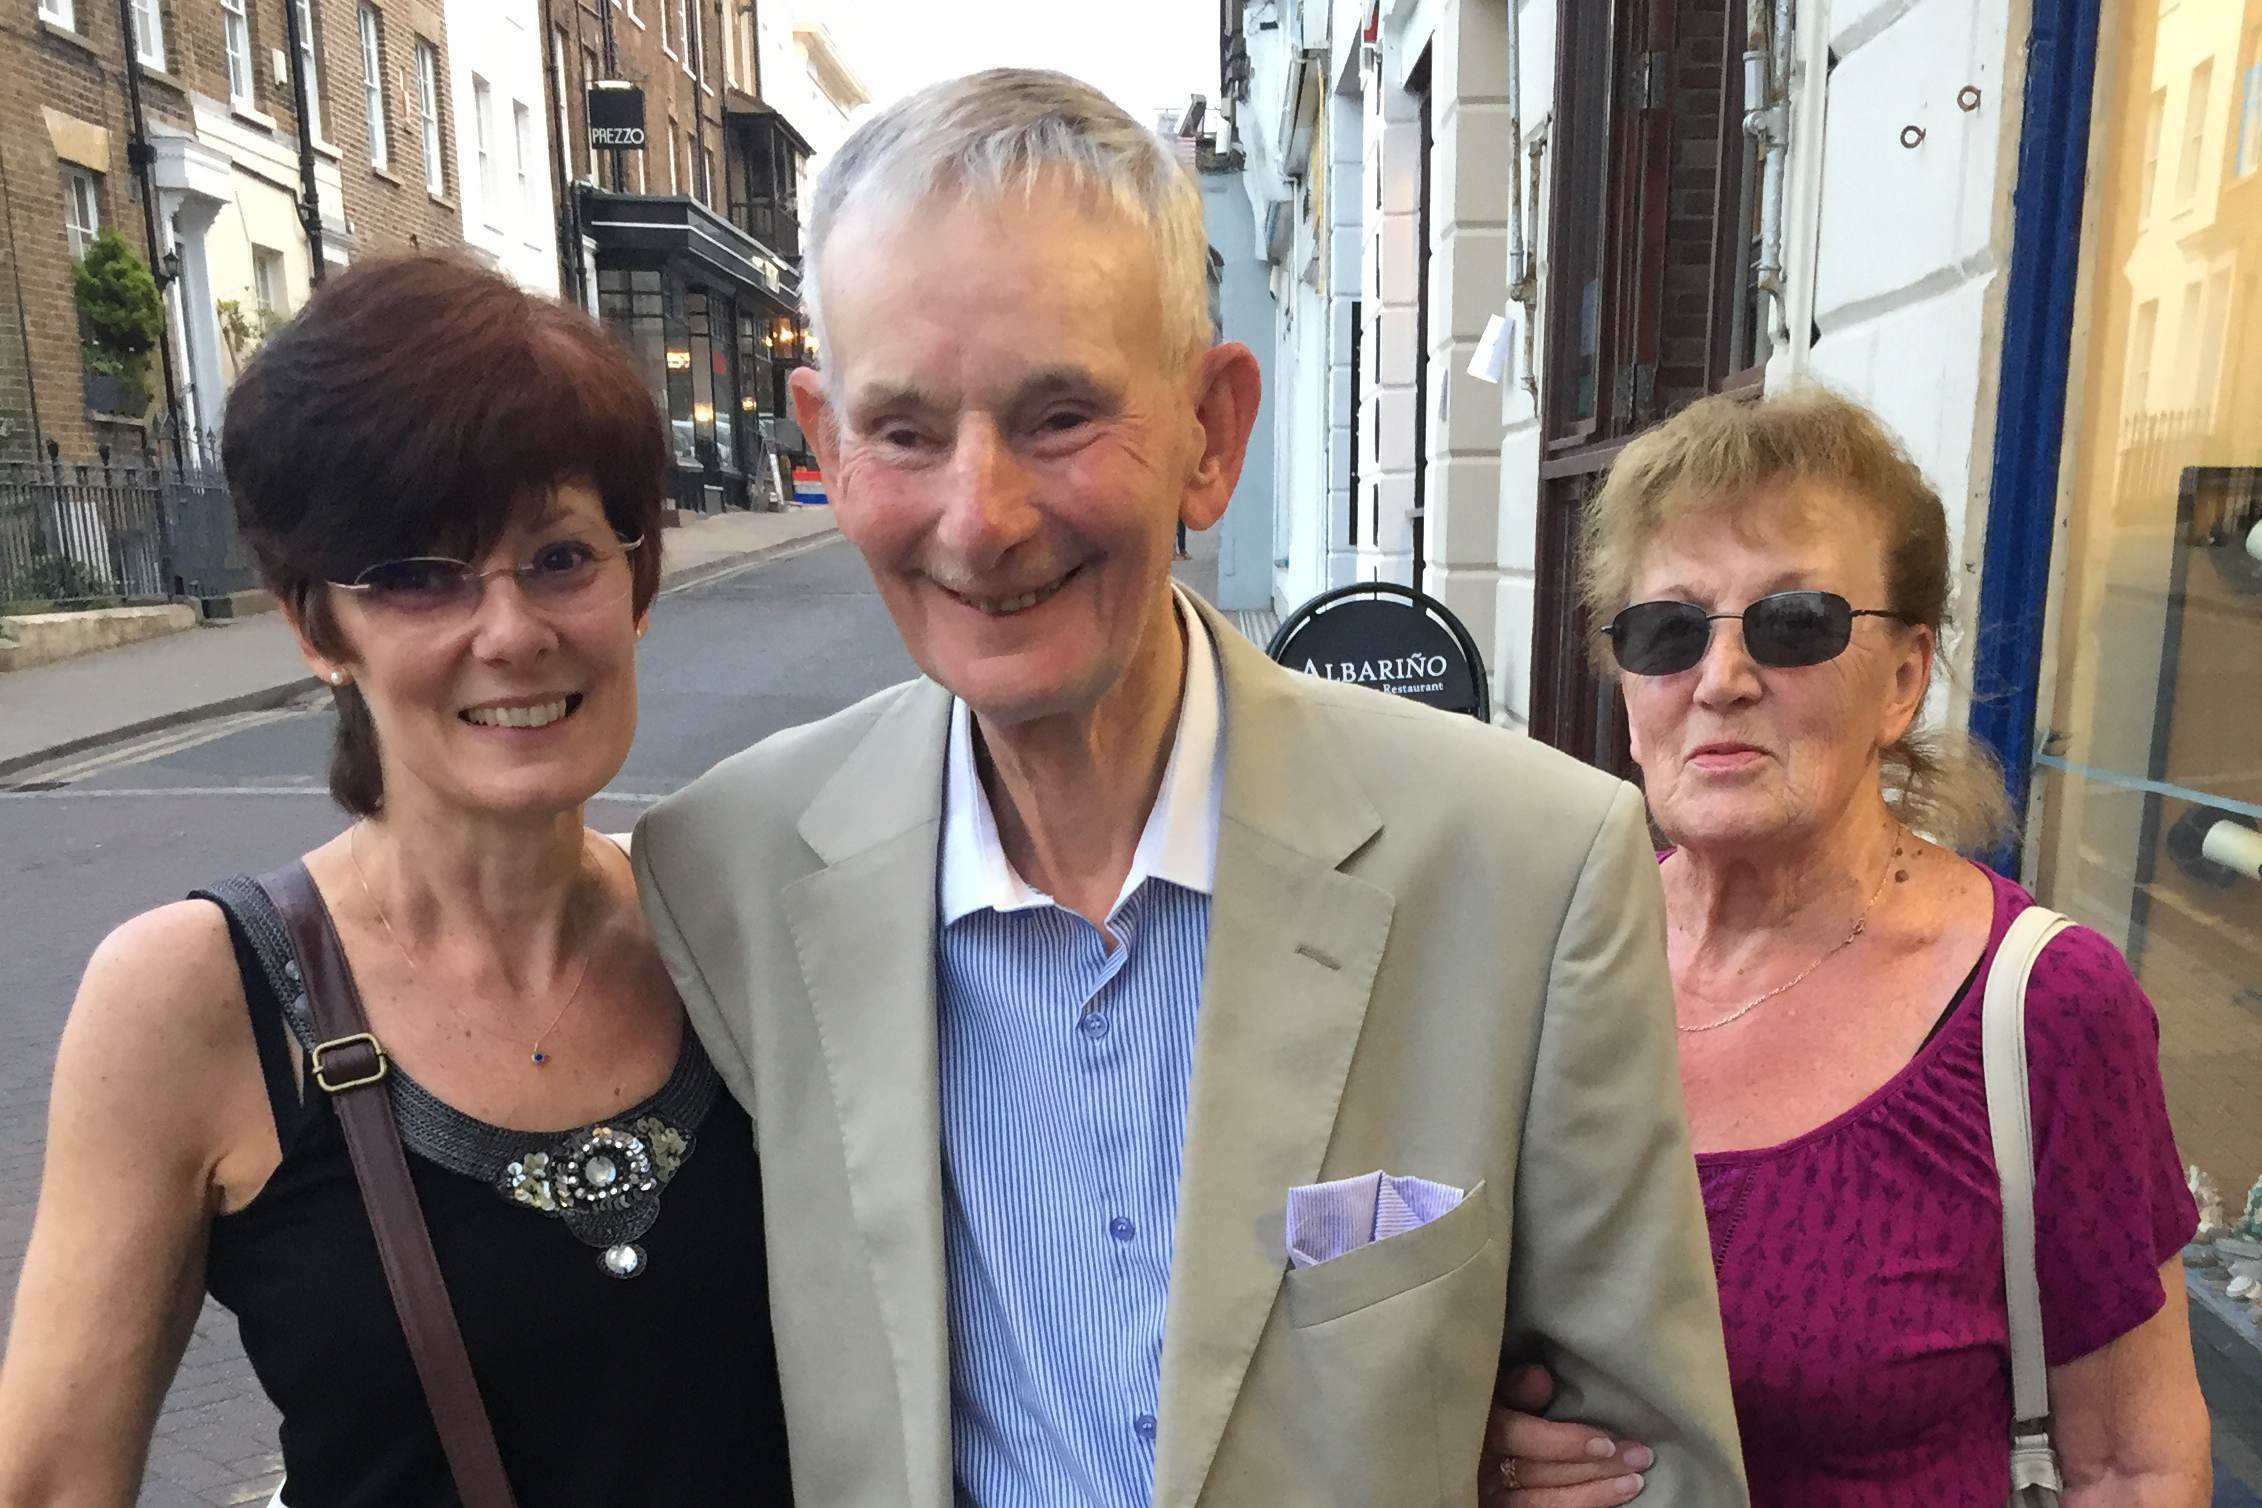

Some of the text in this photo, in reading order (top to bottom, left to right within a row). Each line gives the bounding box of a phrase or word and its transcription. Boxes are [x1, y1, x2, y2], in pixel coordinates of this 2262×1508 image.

[592, 128, 644, 144] PREZZO
[1303, 652, 1447, 683] ALBARIÑO
[1382, 681, 1444, 695] Restaurant
